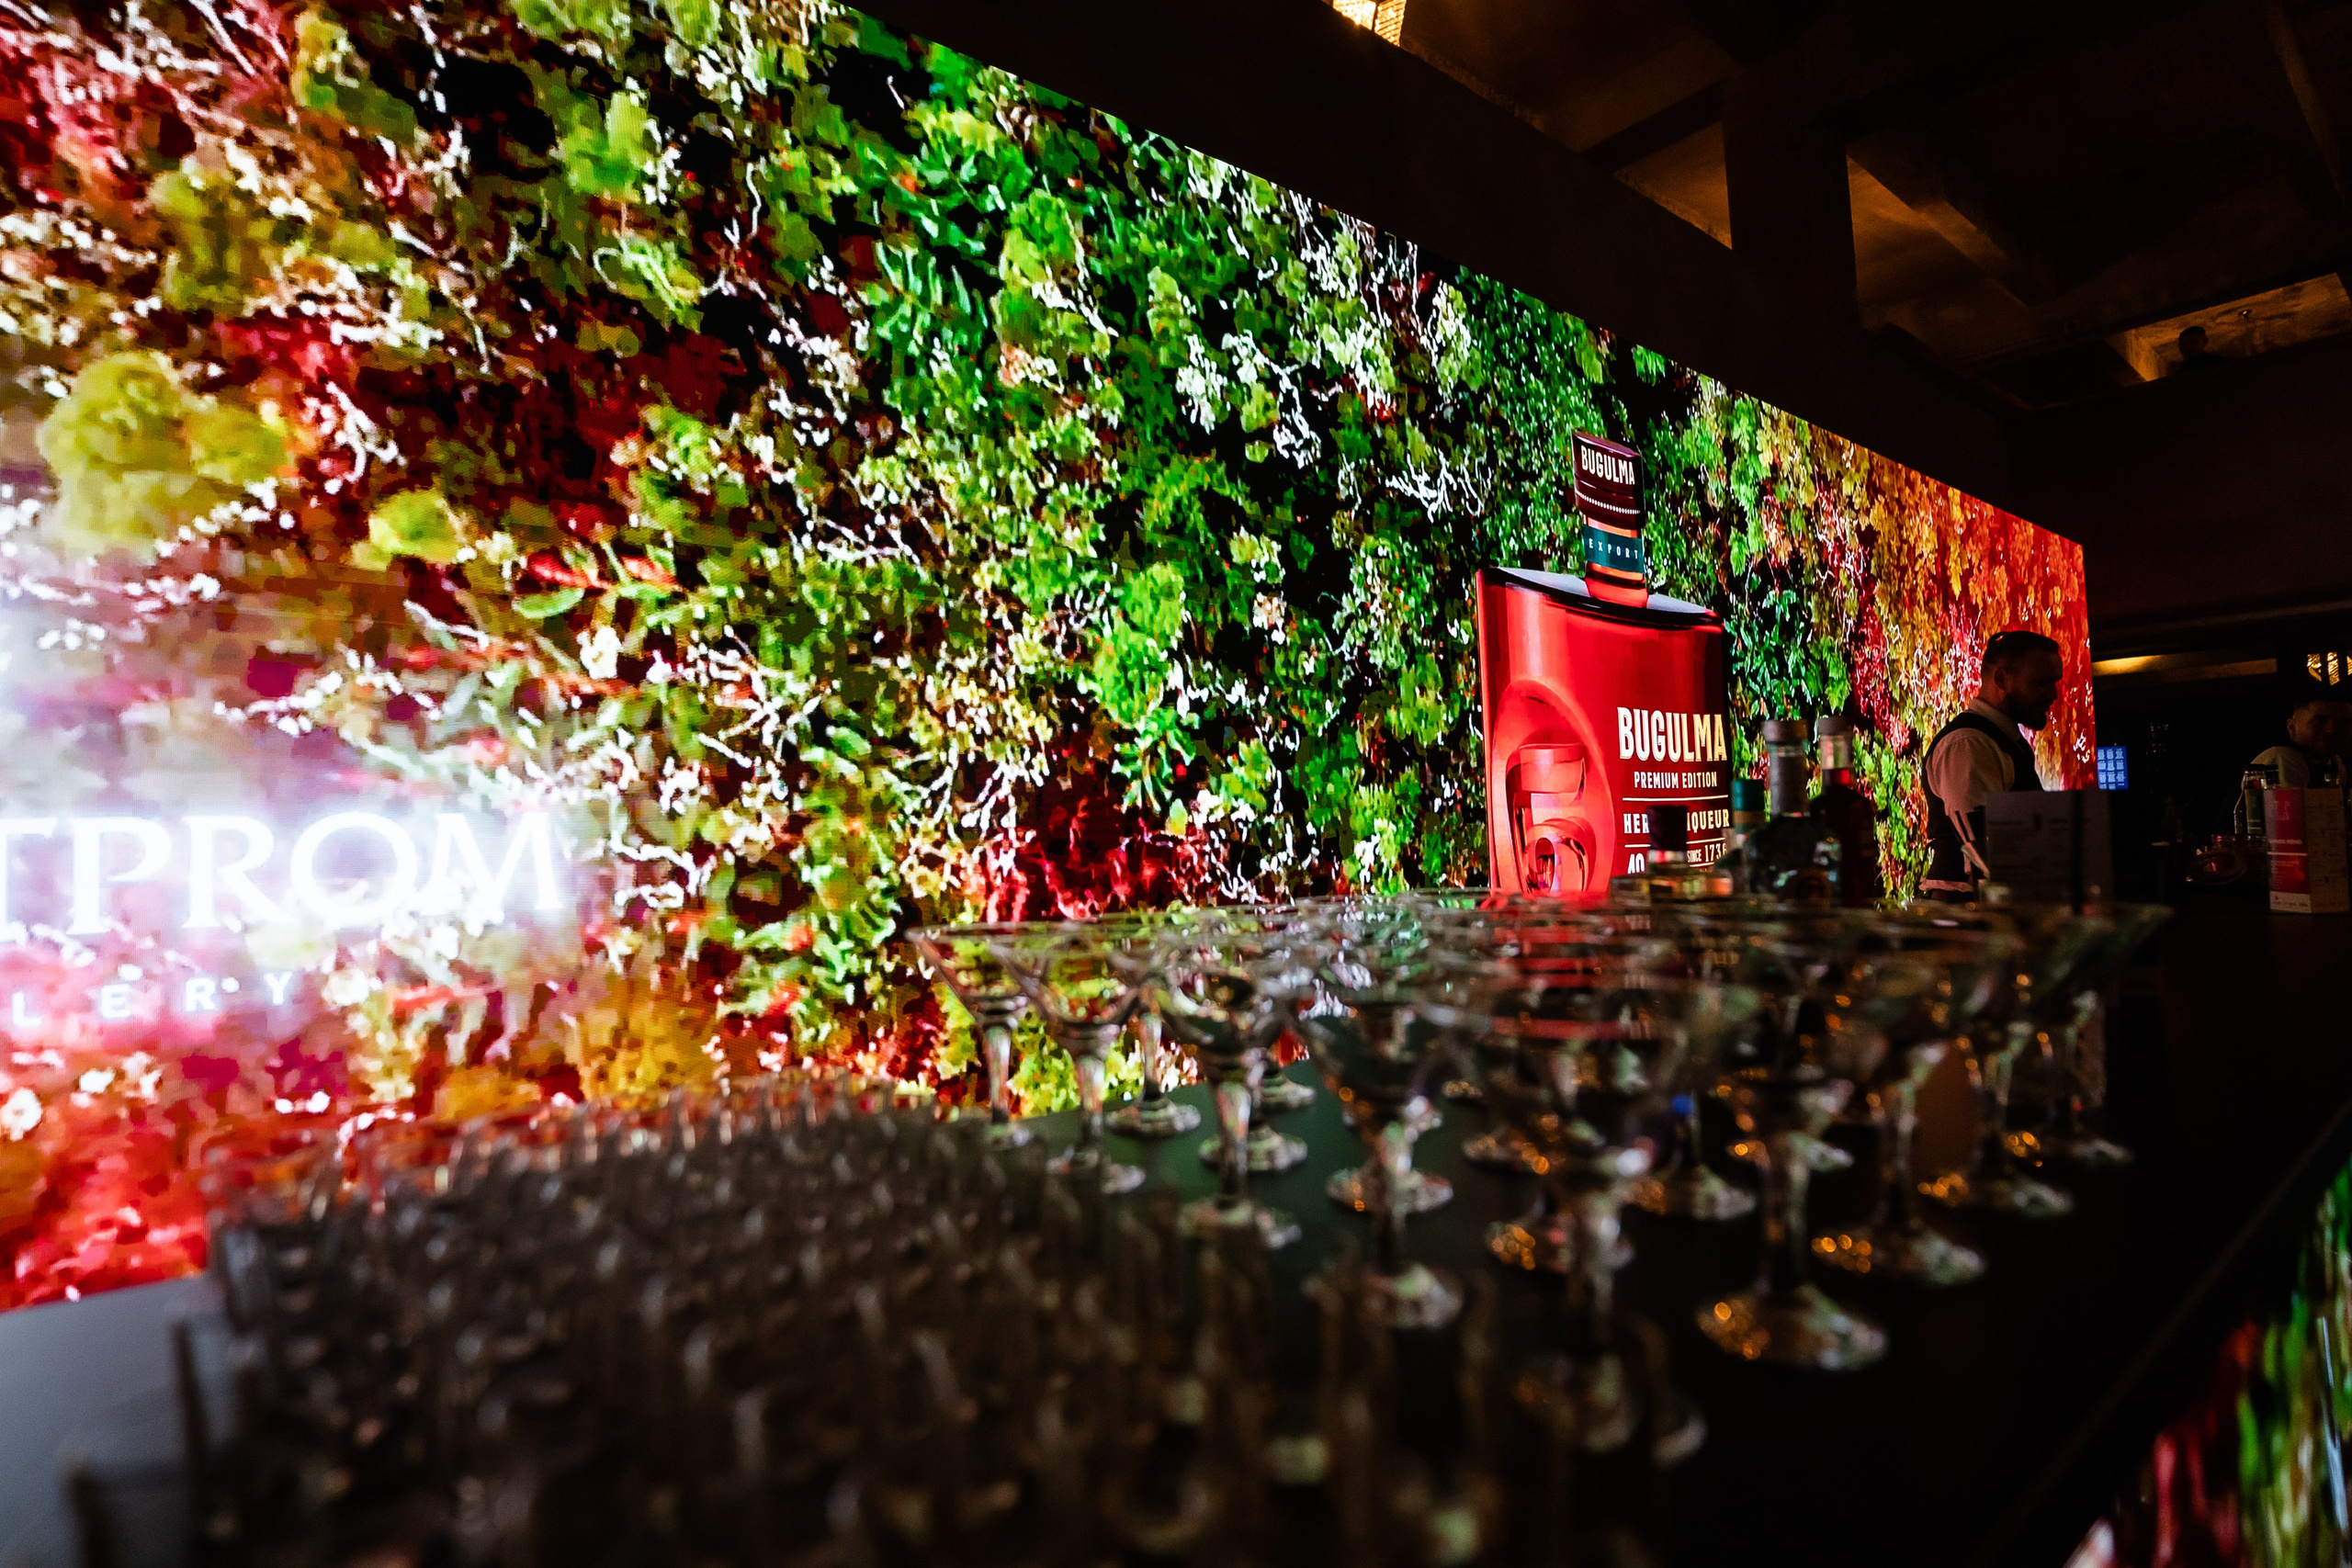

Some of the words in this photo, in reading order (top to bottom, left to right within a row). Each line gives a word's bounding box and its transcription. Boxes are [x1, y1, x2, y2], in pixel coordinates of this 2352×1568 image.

[1580, 445, 1635, 485] BUGULMA
[1589, 537, 1638, 559] EXPORT
[1616, 706, 1728, 762] BUGULMA
[1634, 771, 1679, 789] PREMIUM
[1682, 771, 1718, 789] EDITION
[1623, 813, 1650, 834] HER
[1686, 808, 1730, 833] IQUEUR
[1686, 849, 1702, 863] SINCE
